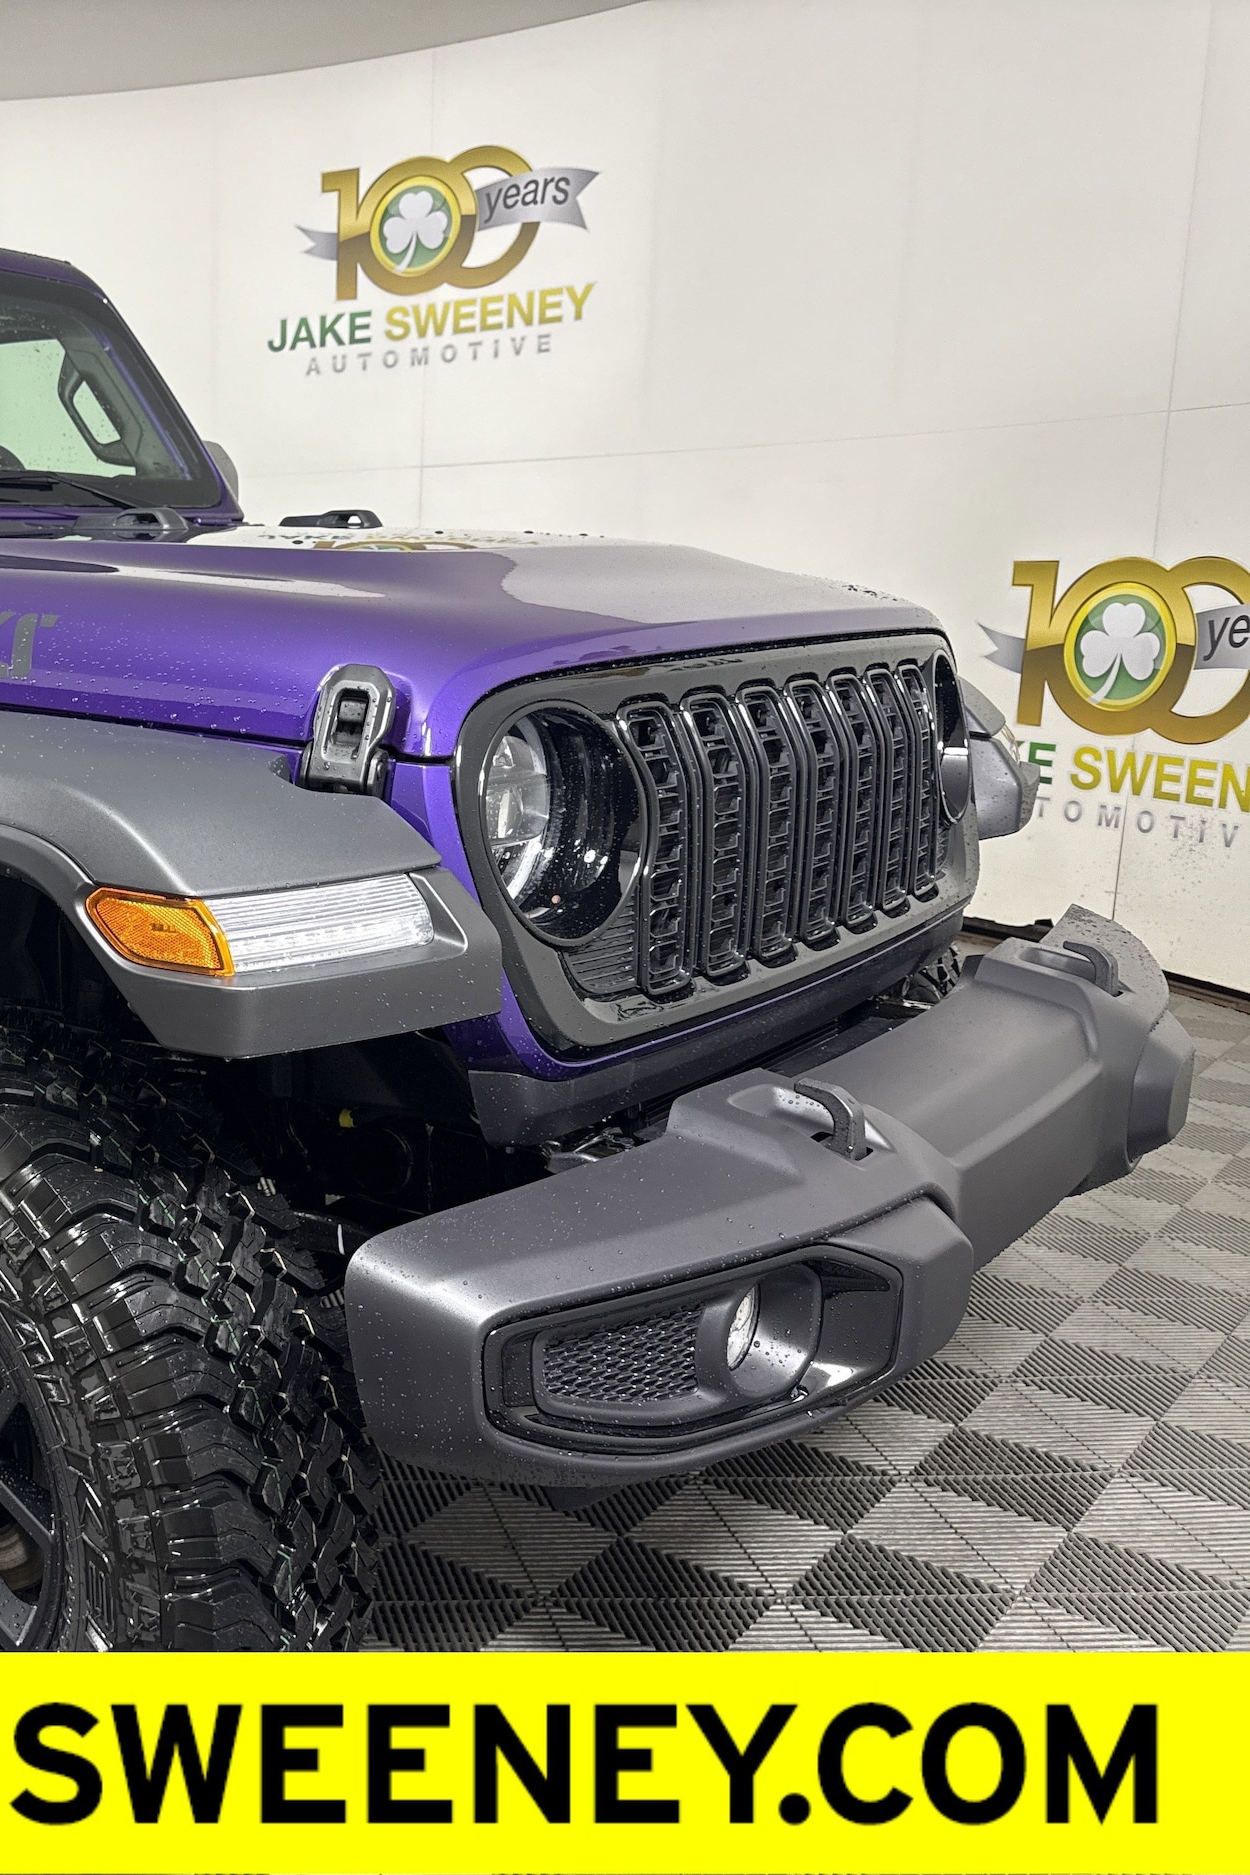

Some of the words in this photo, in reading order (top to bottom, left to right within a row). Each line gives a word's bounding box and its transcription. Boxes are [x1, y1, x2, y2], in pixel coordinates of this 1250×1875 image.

[321, 145, 542, 302] 100
[483, 173, 571, 224] years
[266, 310, 372, 353] JAKE
[384, 282, 595, 342] SWEENEY
[305, 333, 552, 376] AUTOMOTIVE
